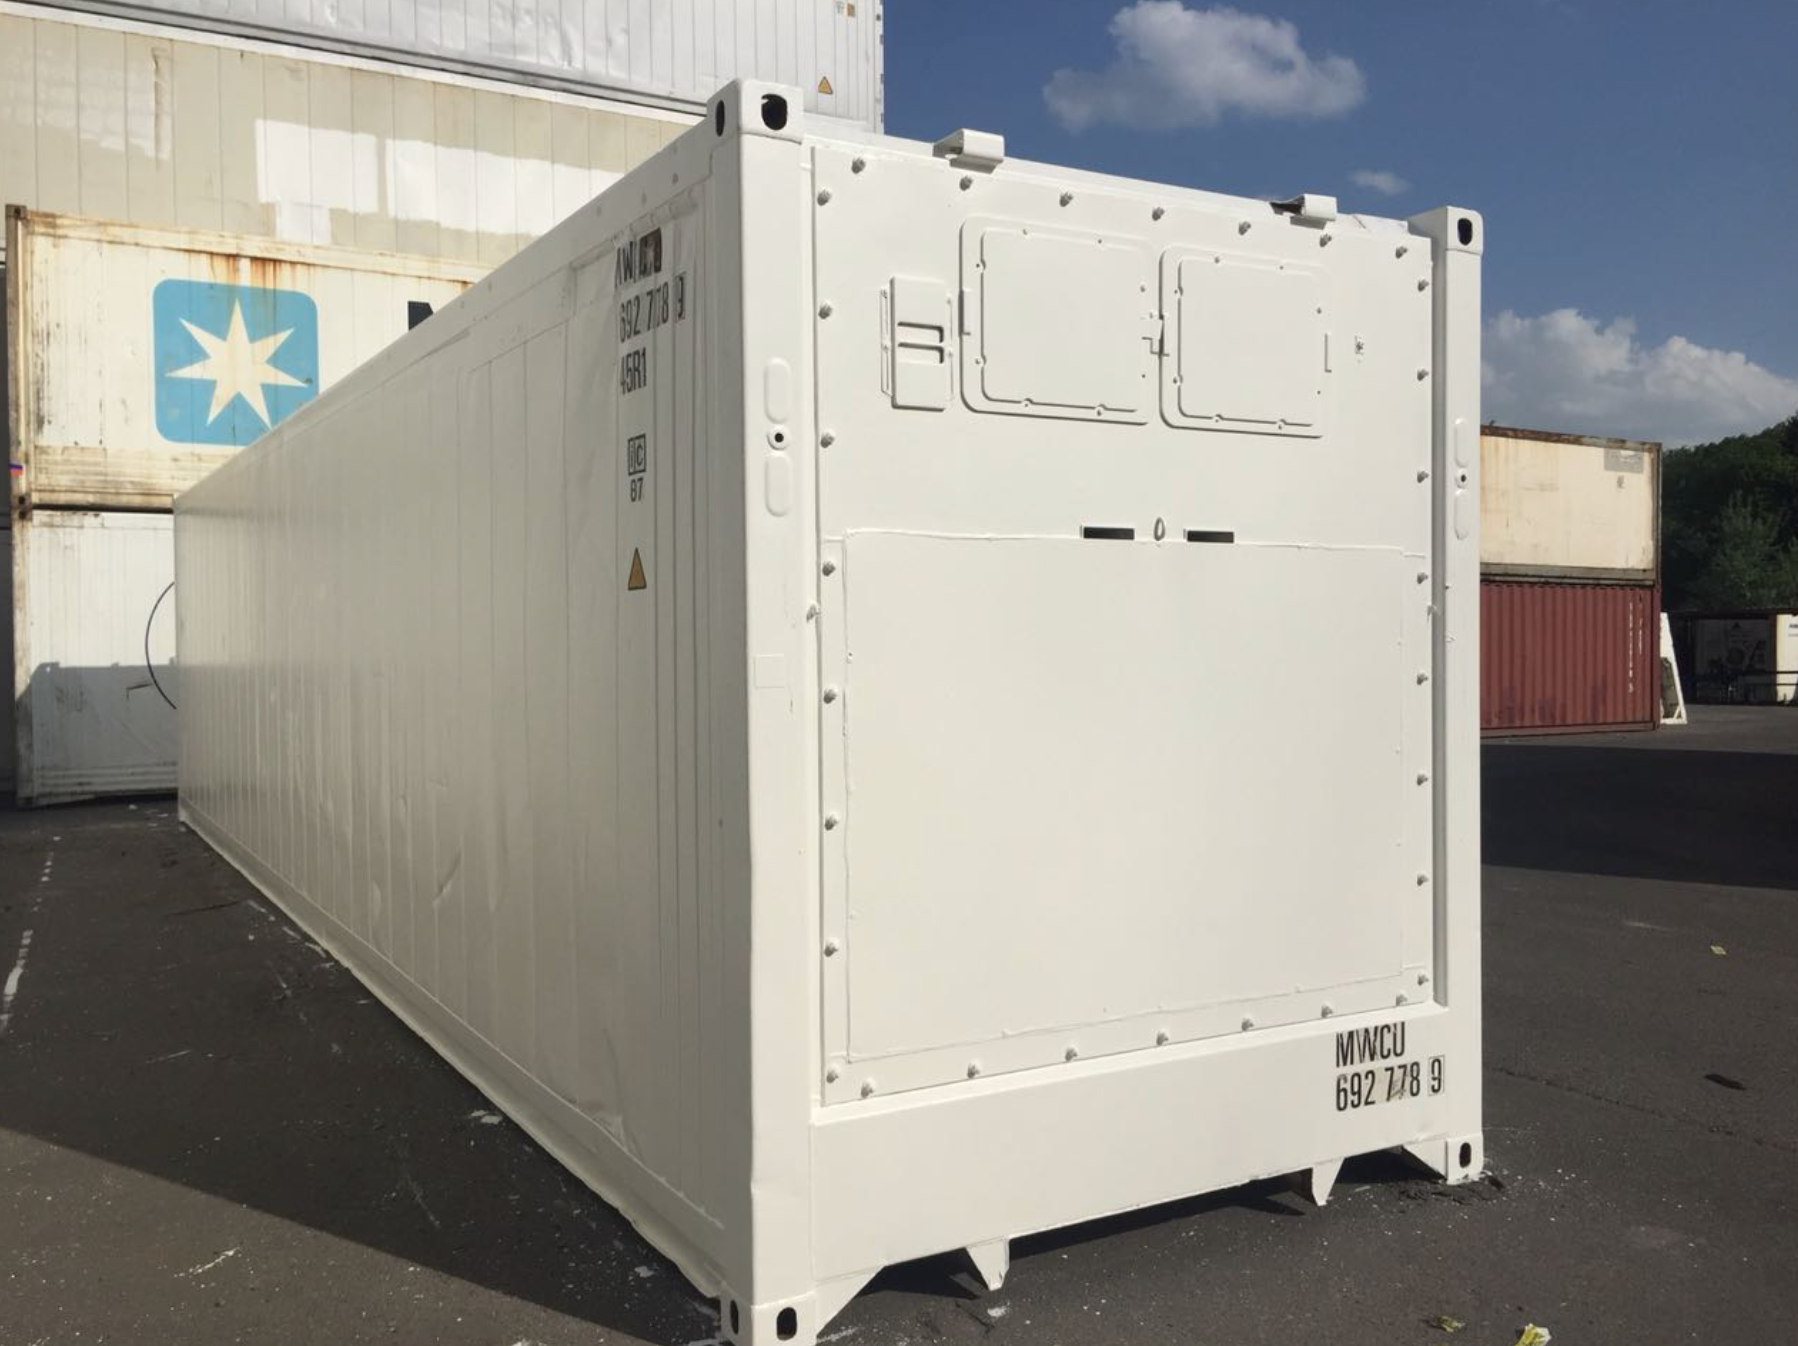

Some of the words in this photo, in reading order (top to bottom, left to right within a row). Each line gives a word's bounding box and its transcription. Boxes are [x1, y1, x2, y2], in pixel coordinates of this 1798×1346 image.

[620, 293, 641, 343] 692
[646, 281, 669, 332] 778
[620, 346, 647, 395] 45R1
[1336, 1021, 1405, 1068] MWCU
[1336, 1069, 1376, 1112] 692
[1384, 1061, 1420, 1102] 778
[1430, 1058, 1442, 1093] 9
